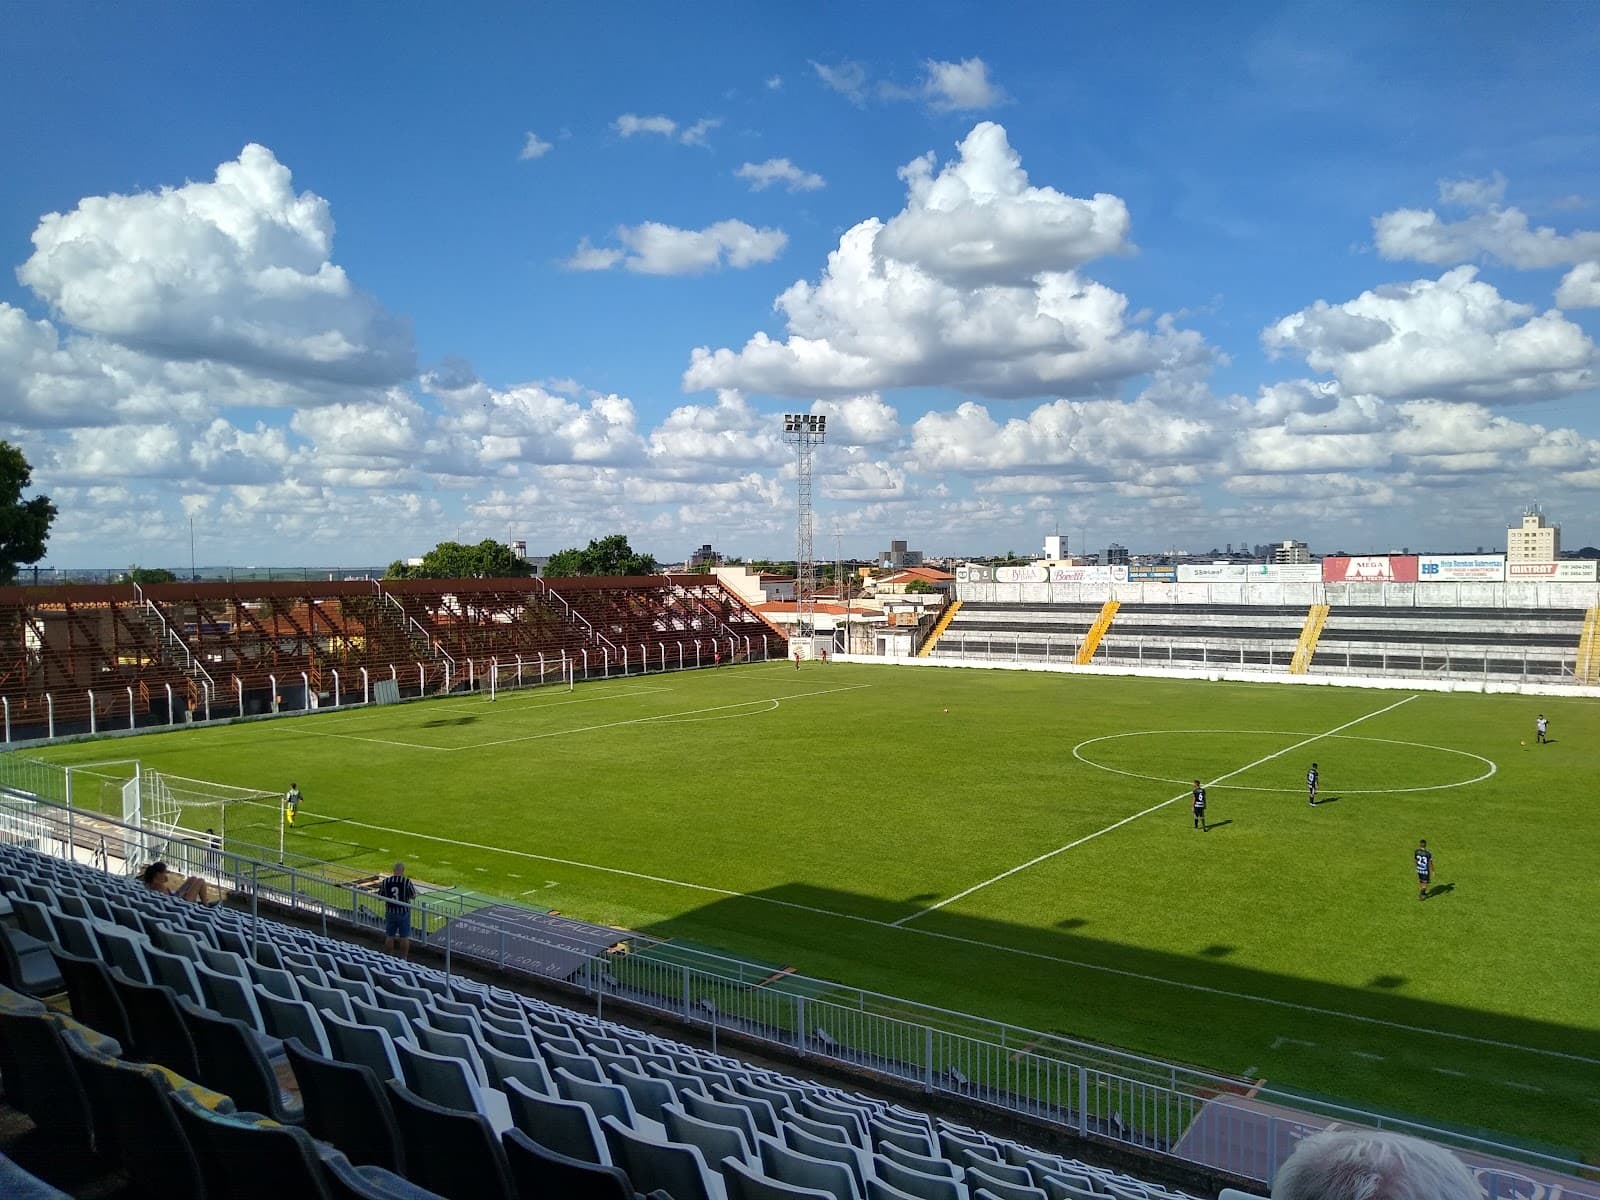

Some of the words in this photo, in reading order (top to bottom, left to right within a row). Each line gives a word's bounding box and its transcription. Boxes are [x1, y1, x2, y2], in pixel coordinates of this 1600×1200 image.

[1421, 563, 1440, 574] HB
[1416, 855, 1428, 866] 23
[391, 886, 399, 902] 3
